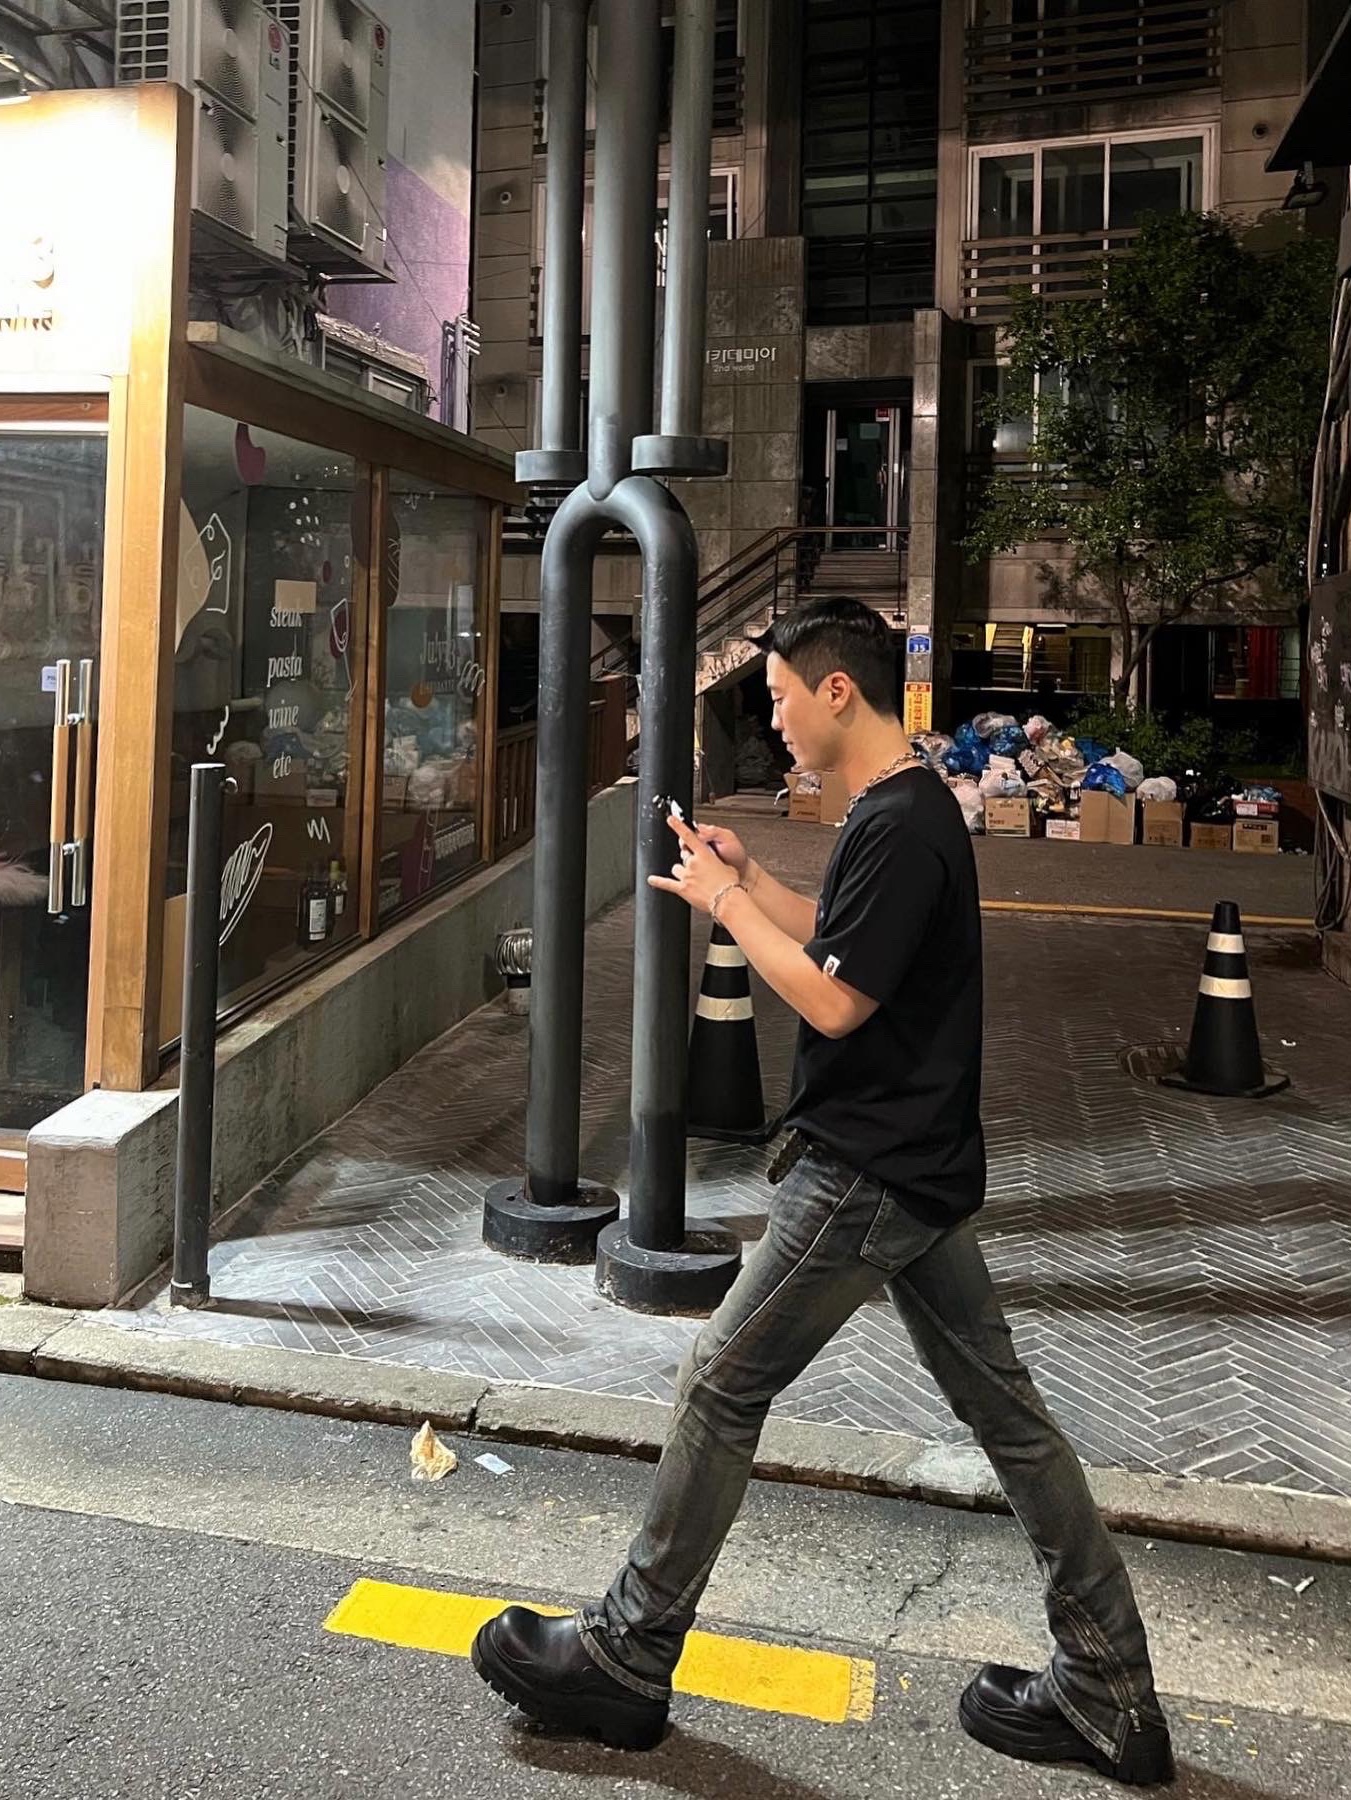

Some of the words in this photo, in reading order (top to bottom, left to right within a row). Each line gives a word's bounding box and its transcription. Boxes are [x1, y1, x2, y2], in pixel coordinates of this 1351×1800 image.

[266, 654, 304, 688] pasta
[269, 699, 299, 730] wine
[272, 752, 293, 780] etc
